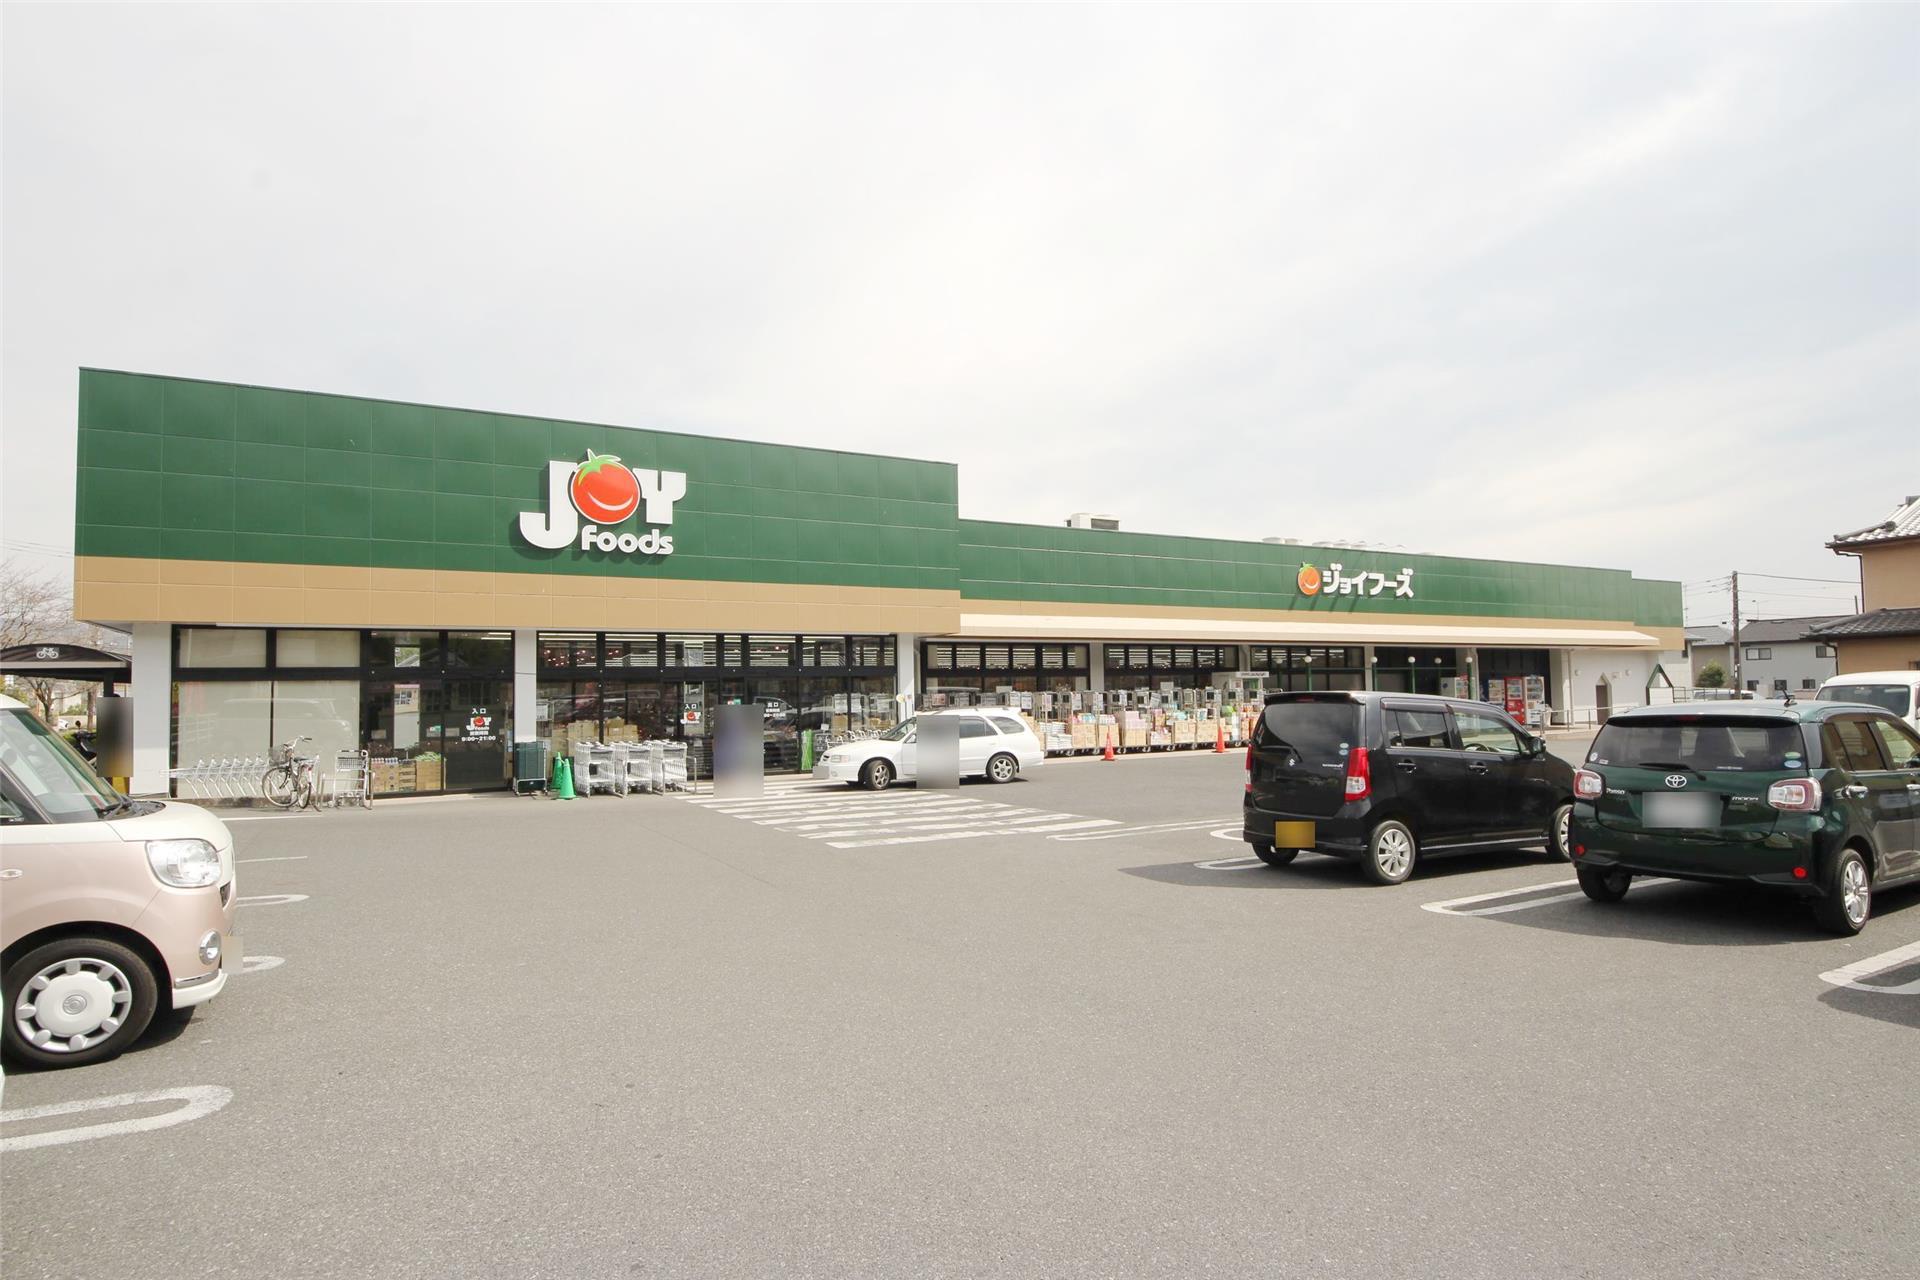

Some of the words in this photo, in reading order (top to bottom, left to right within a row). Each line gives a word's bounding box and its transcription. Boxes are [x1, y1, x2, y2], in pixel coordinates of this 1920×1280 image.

[581, 525, 674, 555] foods
[1322, 563, 1414, 598] ジョイフーズ
